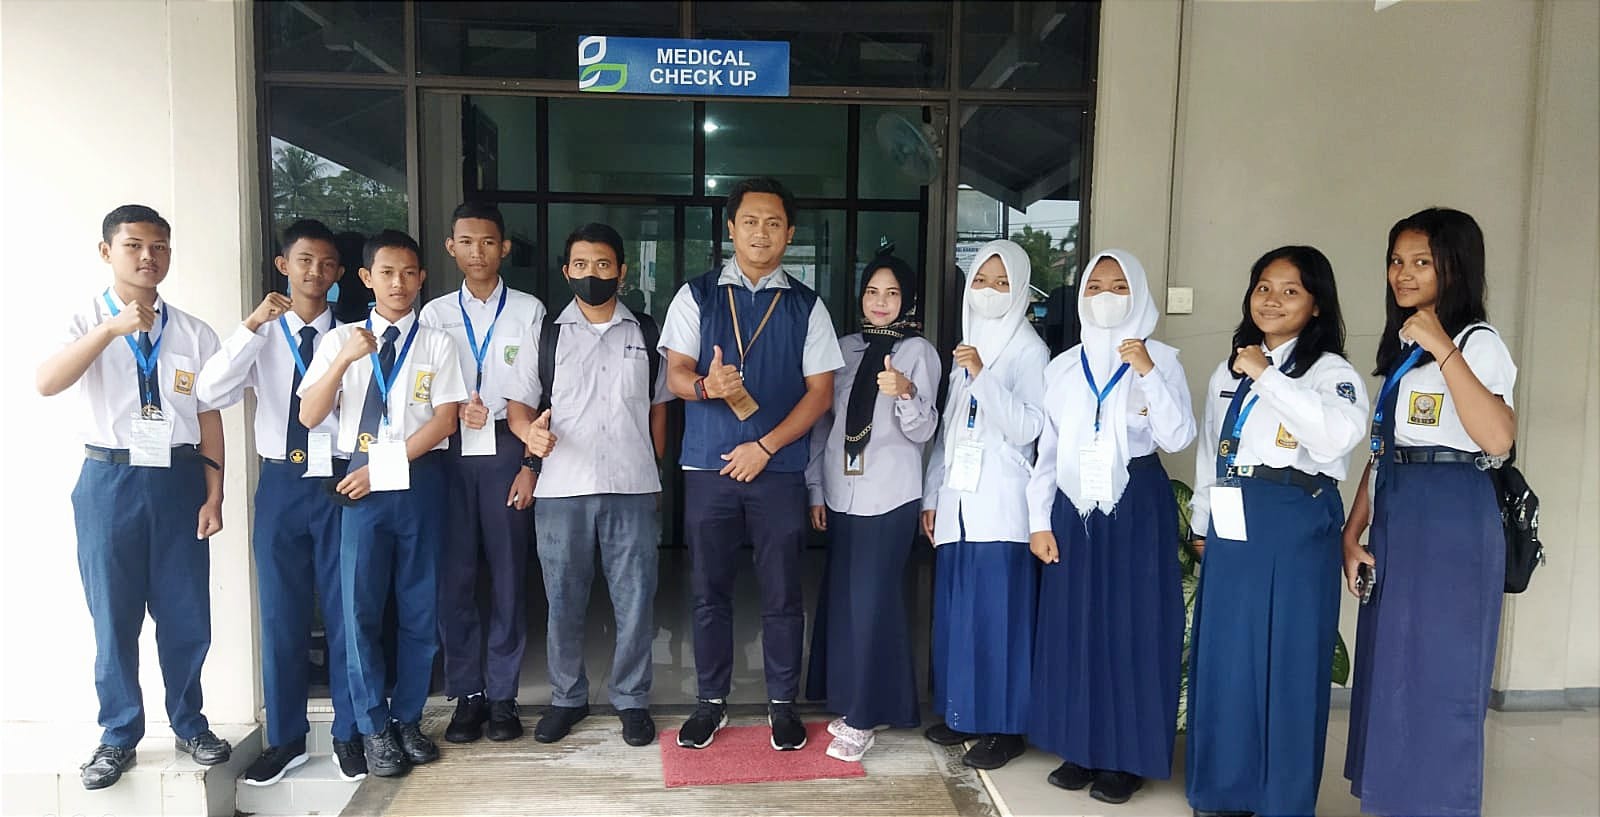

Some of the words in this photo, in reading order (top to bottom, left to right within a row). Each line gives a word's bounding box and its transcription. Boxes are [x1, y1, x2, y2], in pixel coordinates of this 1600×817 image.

[657, 48, 750, 66] MEDICAL
[650, 69, 723, 86] CHECK
[729, 70, 757, 86] UP
